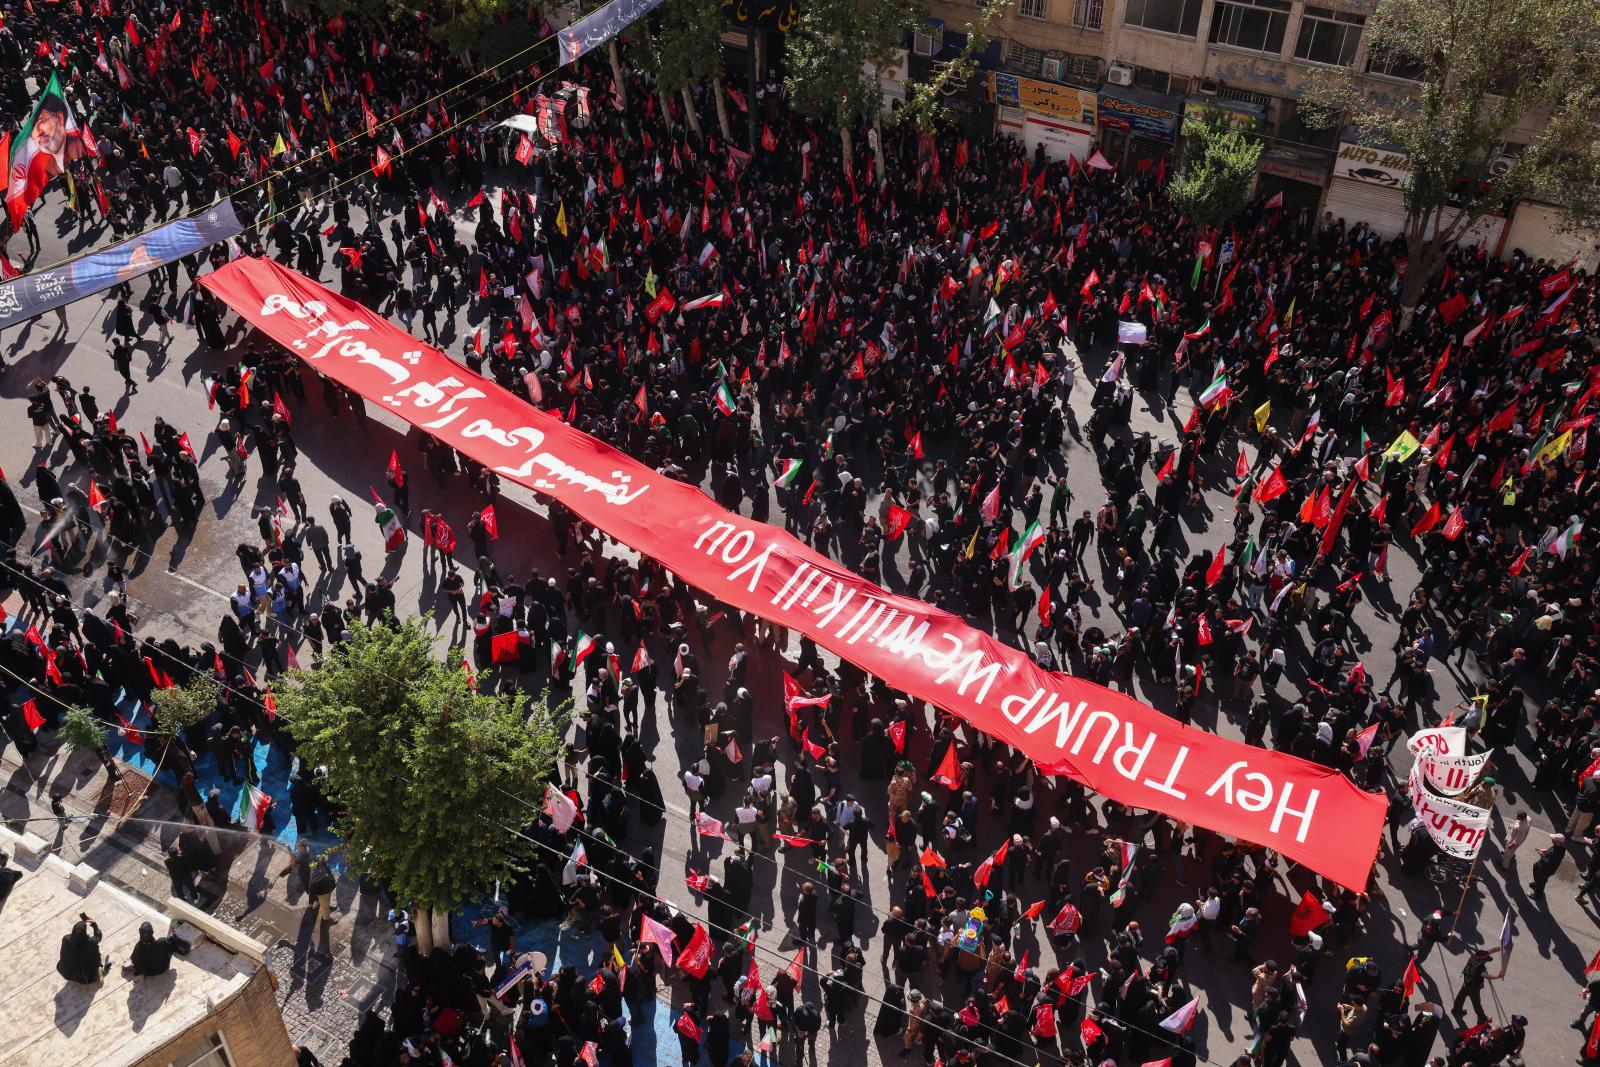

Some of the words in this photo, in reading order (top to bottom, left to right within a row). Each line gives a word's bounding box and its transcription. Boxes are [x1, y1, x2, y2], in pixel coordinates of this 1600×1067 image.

[1337, 146, 1379, 166] AUTO
[292, 319, 423, 387] ترامپ
[693, 519, 779, 593] You
[922, 632, 1004, 705] We
[1001, 687, 1188, 801] TRUMP
[1205, 760, 1320, 843] Hey
